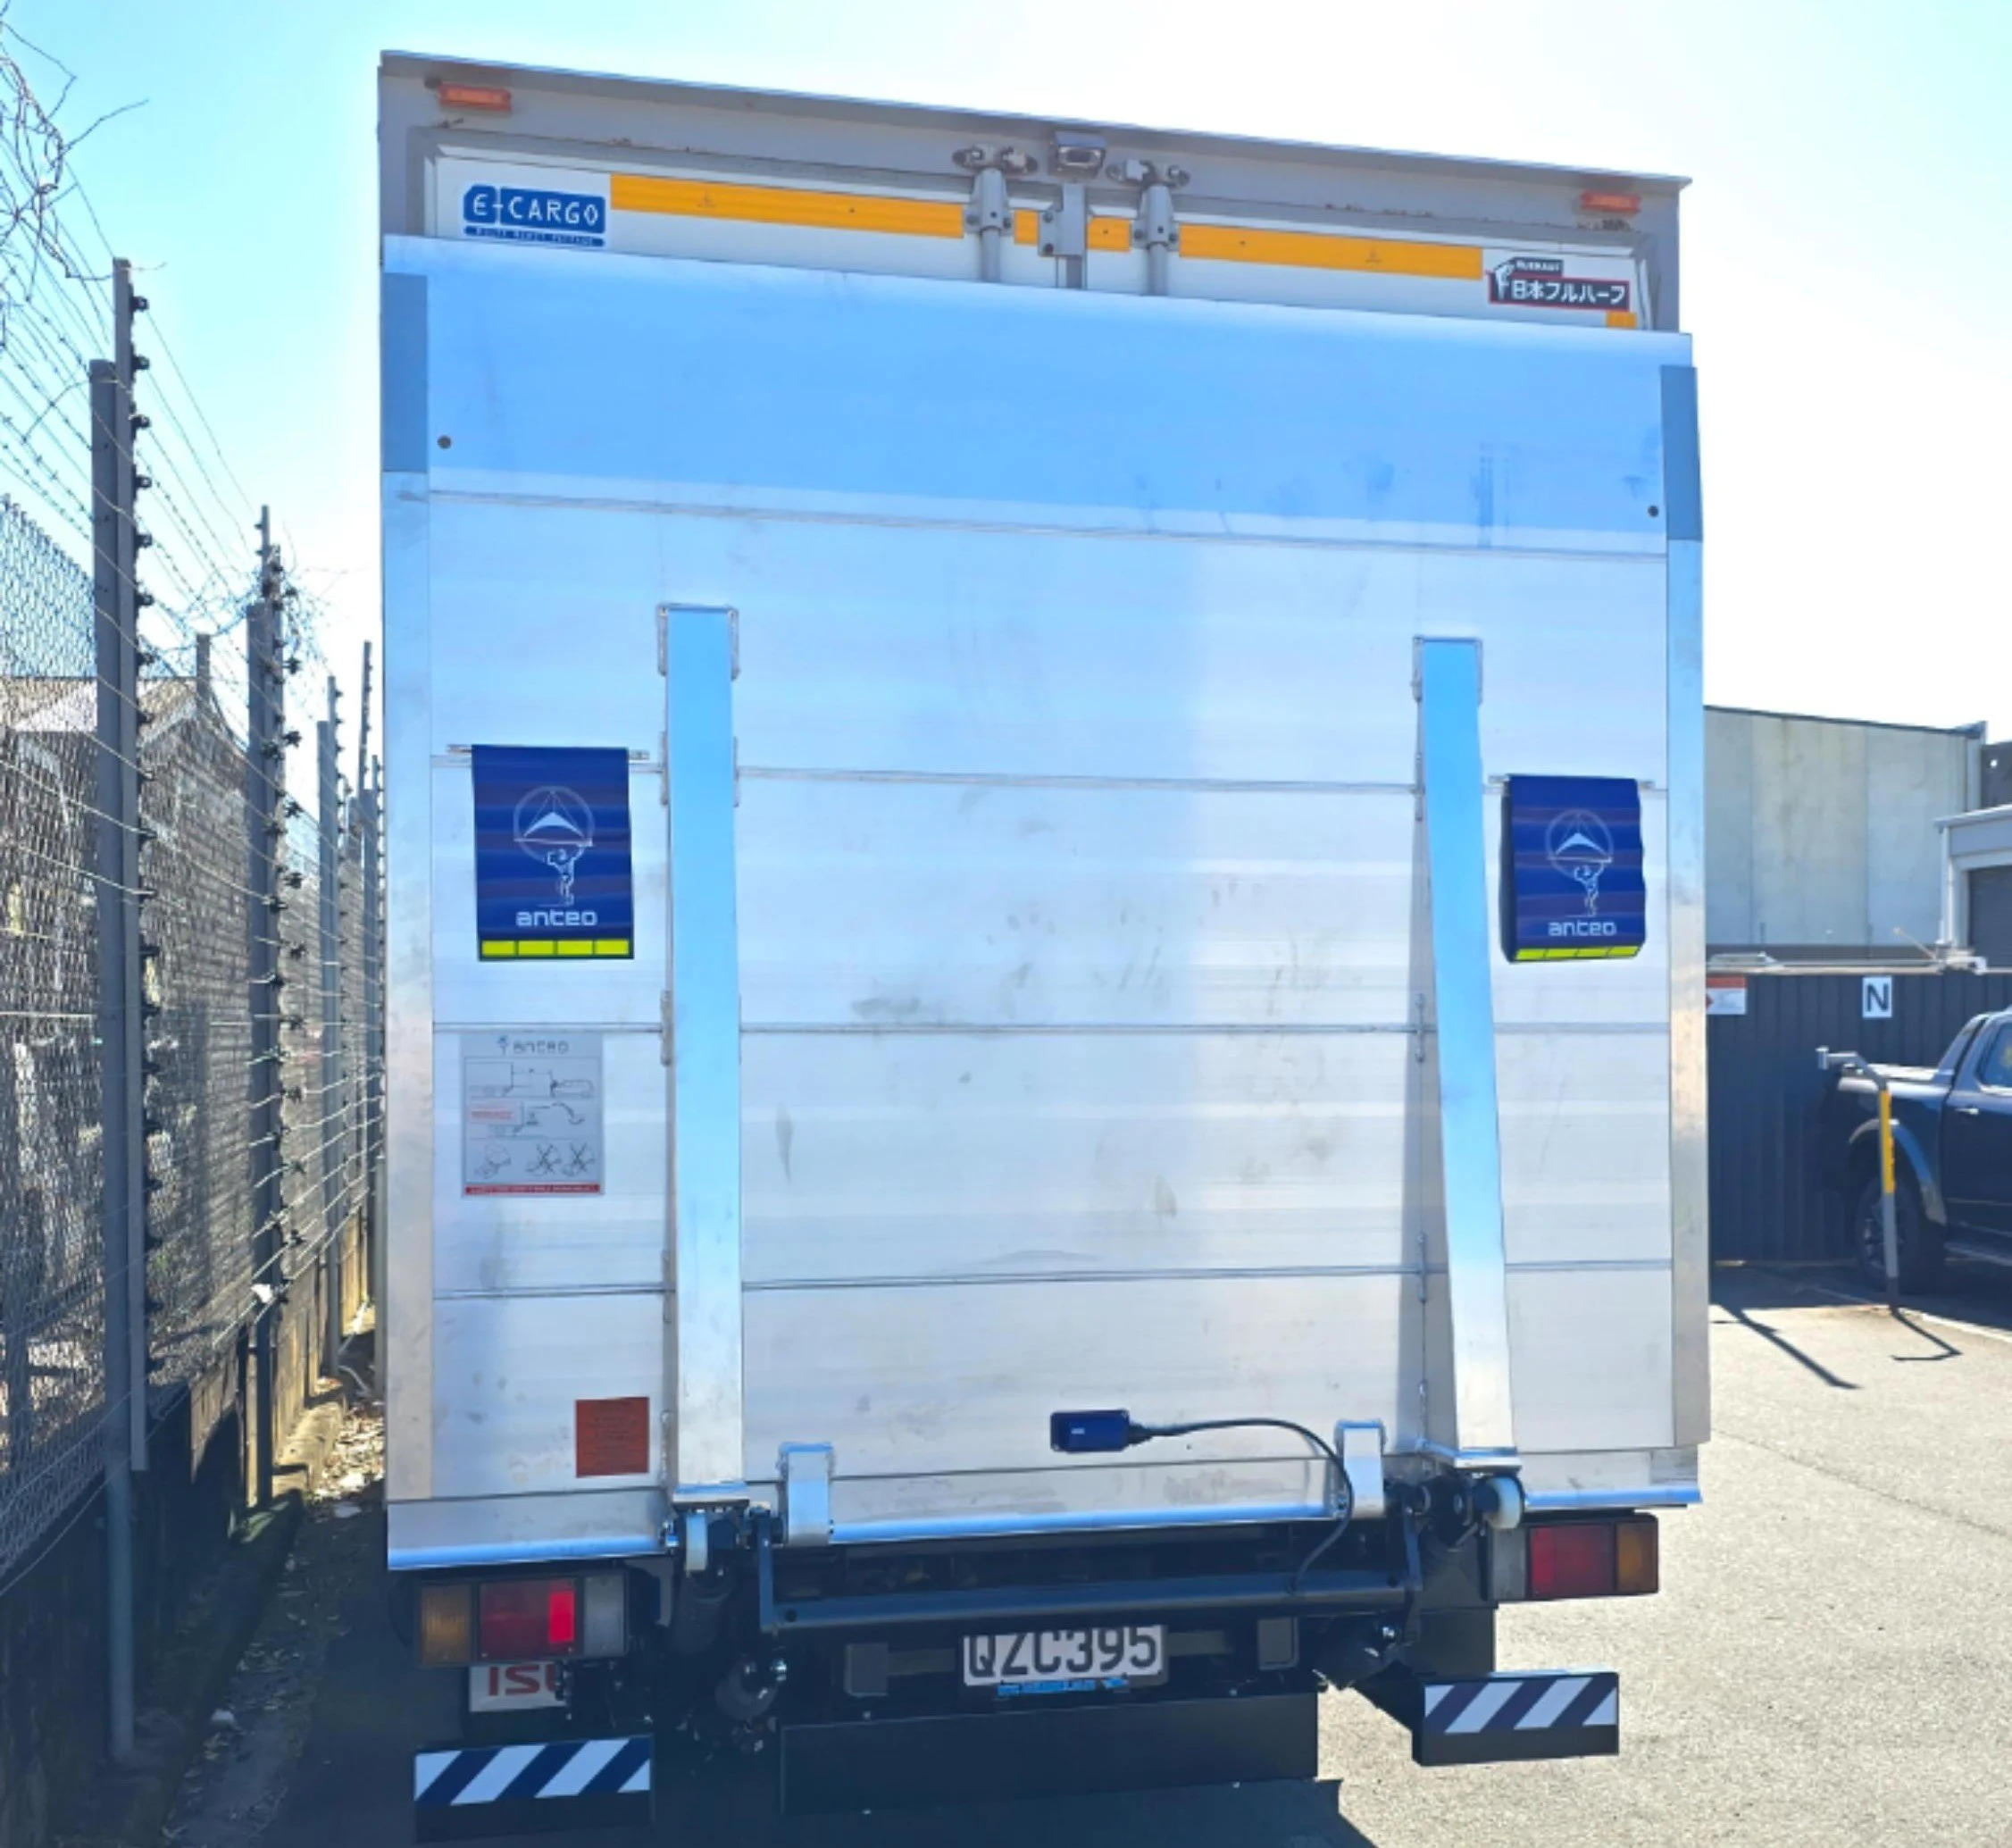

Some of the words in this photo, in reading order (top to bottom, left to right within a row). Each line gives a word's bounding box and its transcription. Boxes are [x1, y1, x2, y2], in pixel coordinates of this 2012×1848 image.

[472, 193, 599, 227] E-CARGO
[1511, 279, 1626, 305] 日本フルハーフ
[514, 909, 598, 927] anteo
[1548, 920, 1617, 937] anteo
[1866, 983, 1890, 1013] N
[969, 1625, 1157, 1678] QZC395
